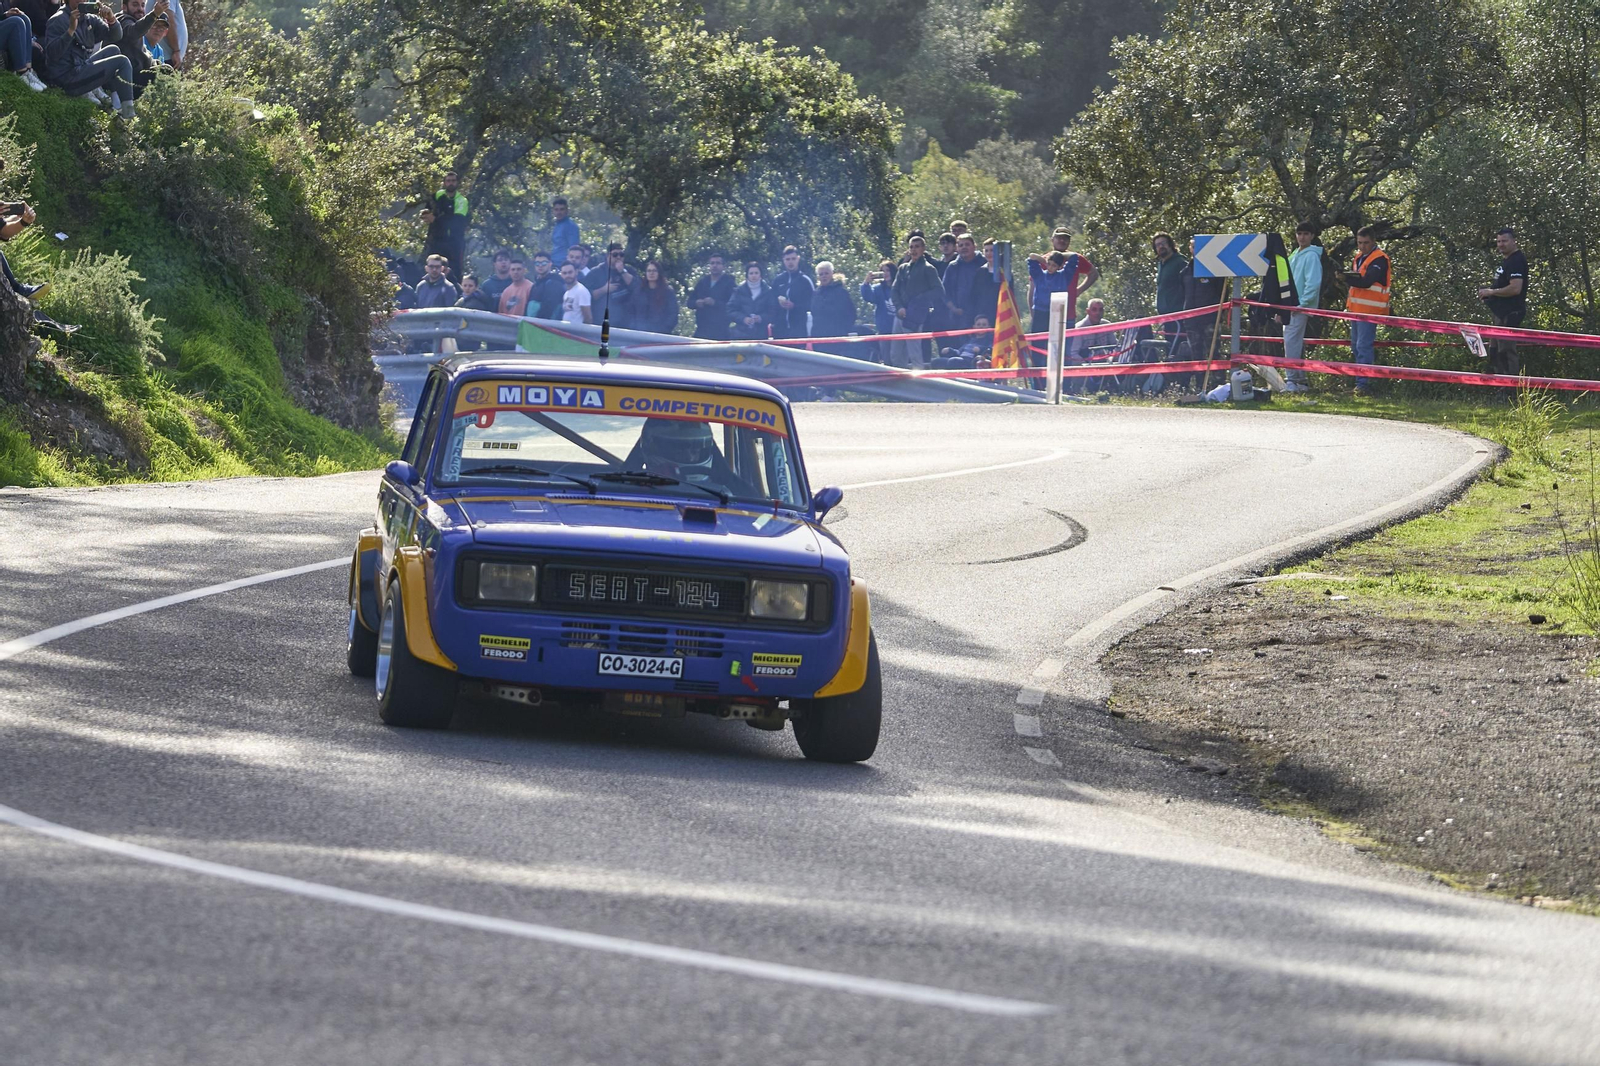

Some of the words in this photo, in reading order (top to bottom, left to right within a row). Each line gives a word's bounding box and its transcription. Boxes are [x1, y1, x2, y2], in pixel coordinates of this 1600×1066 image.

[499, 386, 603, 407] MOYA
[619, 396, 776, 427] COMPETICION
[464, 415, 477, 424] 154
[480, 636, 529, 647] MICHELIN
[484, 648, 524, 659] FERODO
[753, 654, 801, 664] MICHELIN
[601, 655, 682, 675] CO-3024-G
[755, 666, 795, 675] FERODO
